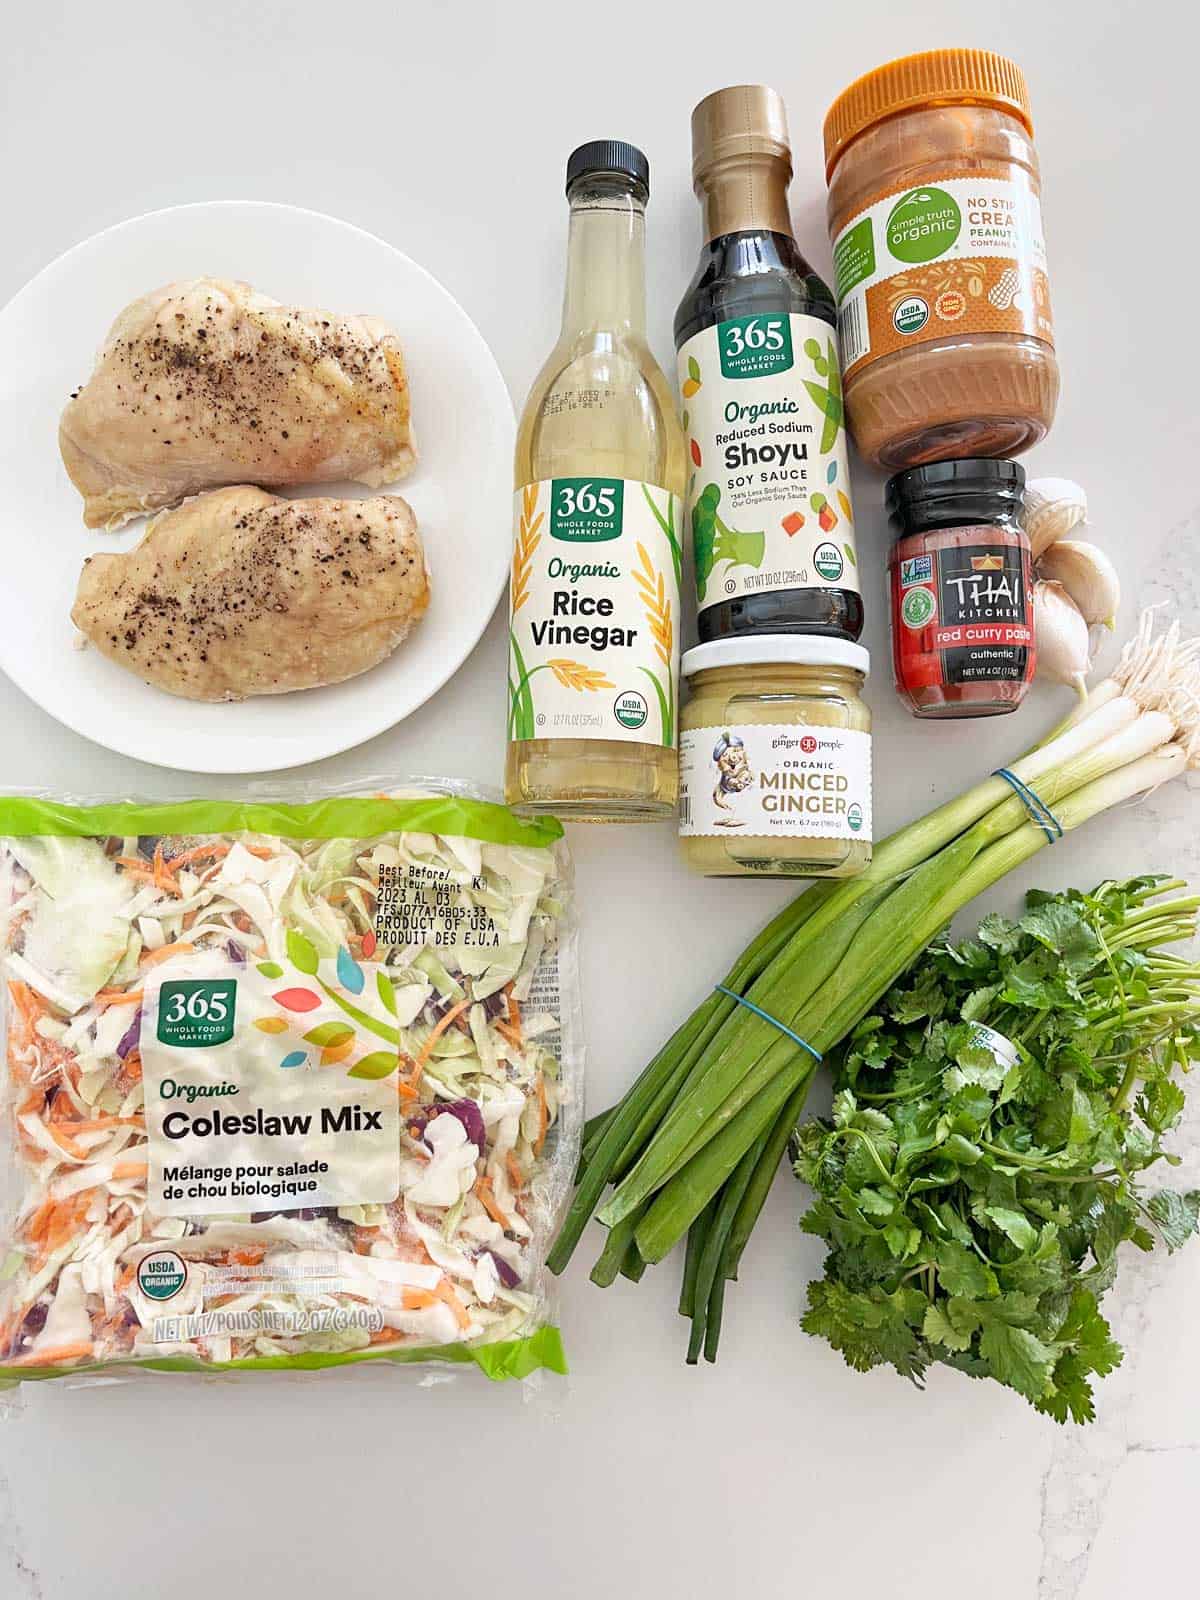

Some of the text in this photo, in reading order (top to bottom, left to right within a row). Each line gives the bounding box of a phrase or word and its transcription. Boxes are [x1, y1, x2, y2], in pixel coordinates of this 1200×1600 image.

[968, 198, 987, 208] NO
[892, 208, 954, 232] simple truth
[968, 212, 1014, 226] CREA
[892, 218, 957, 245] organic
[970, 228, 1011, 238] PEANUT
[901, 304, 920, 316] USDA
[726, 320, 784, 357] 365
[728, 357, 756, 368] WHOLE
[741, 362, 774, 372] MARKET
[724, 398, 799, 424] Organic
[716, 422, 813, 446] Reduced Sodium
[724, 443, 808, 469] Shoyu
[728, 470, 808, 490] SOY SAUCE
[764, 486, 790, 494] Sodium
[557, 484, 616, 517] 365
[746, 496, 772, 504] Organic
[820, 552, 837, 560] USDA
[548, 558, 620, 583] Organic
[744, 575, 754, 589] NET
[754, 574, 765, 588] WT
[765, 574, 773, 586] 10
[773, 572, 782, 585] OZ
[946, 574, 1019, 606] THAI
[553, 590, 614, 616] Rice
[958, 608, 1018, 618] KITCHEN
[531, 620, 638, 651] Vinegar
[937, 628, 1031, 644] red curry paste
[970, 650, 1014, 659] authentic
[962, 668, 975, 676] NET
[622, 700, 642, 710] USDA
[772, 739, 799, 749] ginger
[818, 740, 843, 750] people
[783, 760, 834, 770] ORGANIC
[760, 772, 848, 792] MINCED
[762, 794, 846, 814] GINGER
[378, 864, 451, 880] Best Before/
[378, 876, 462, 894] Meilleur Avant
[377, 888, 450, 906] 2023 AL 03
[376, 915, 495, 932] PRODUCT OF USA
[376, 930, 500, 946] PRODUIT DES E.U.A
[166, 988, 228, 1022] 365
[166, 1026, 195, 1034] WHOLE
[160, 1079, 240, 1104] Organic
[162, 1104, 382, 1140] Coleslaw Mix
[163, 1160, 329, 1183] Mélange pour salade
[163, 1179, 318, 1200] de chou biologique
[148, 1262, 176, 1273] USDA
[145, 1276, 179, 1287] ORGANIC
[154, 1308, 384, 1342] NET WT/POIDS NET 12 OZ (340g)
